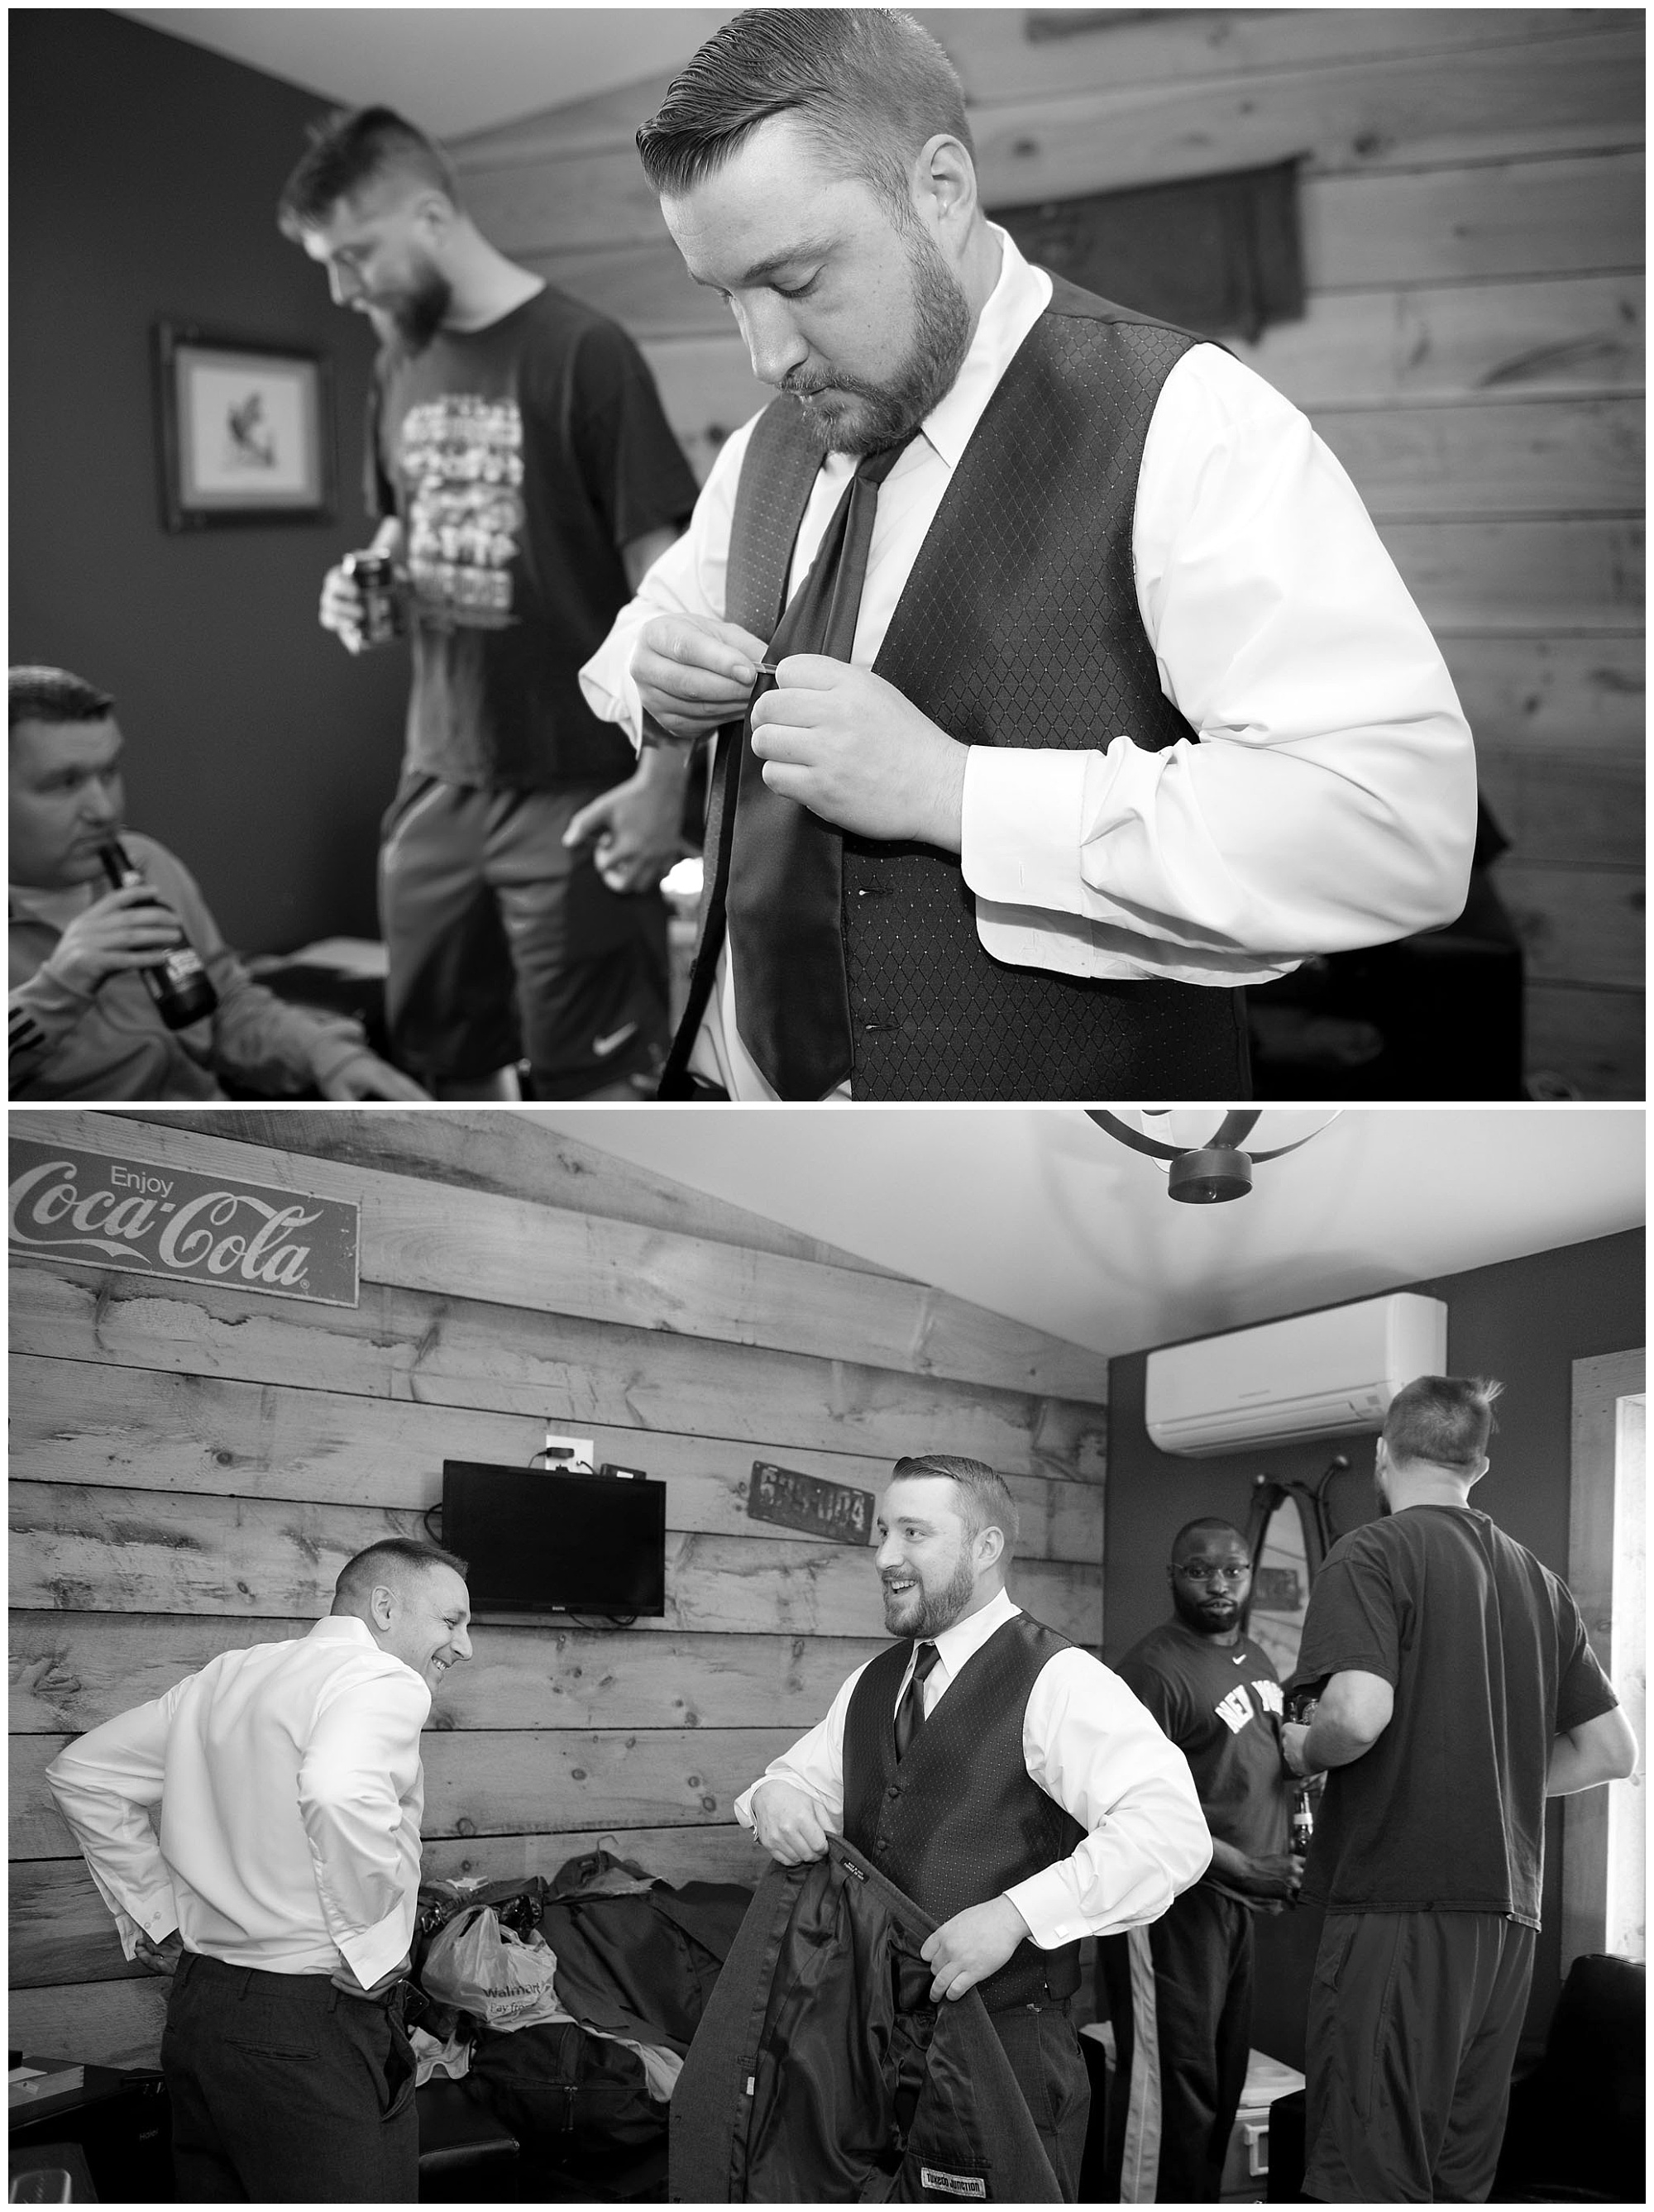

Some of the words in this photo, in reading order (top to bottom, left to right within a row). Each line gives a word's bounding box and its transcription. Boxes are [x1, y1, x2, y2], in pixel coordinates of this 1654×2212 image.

[110, 1164, 174, 1197] Enjoy
[8, 1161, 323, 1286] Coca-Cola
[481, 1982, 542, 1999] Walmart
